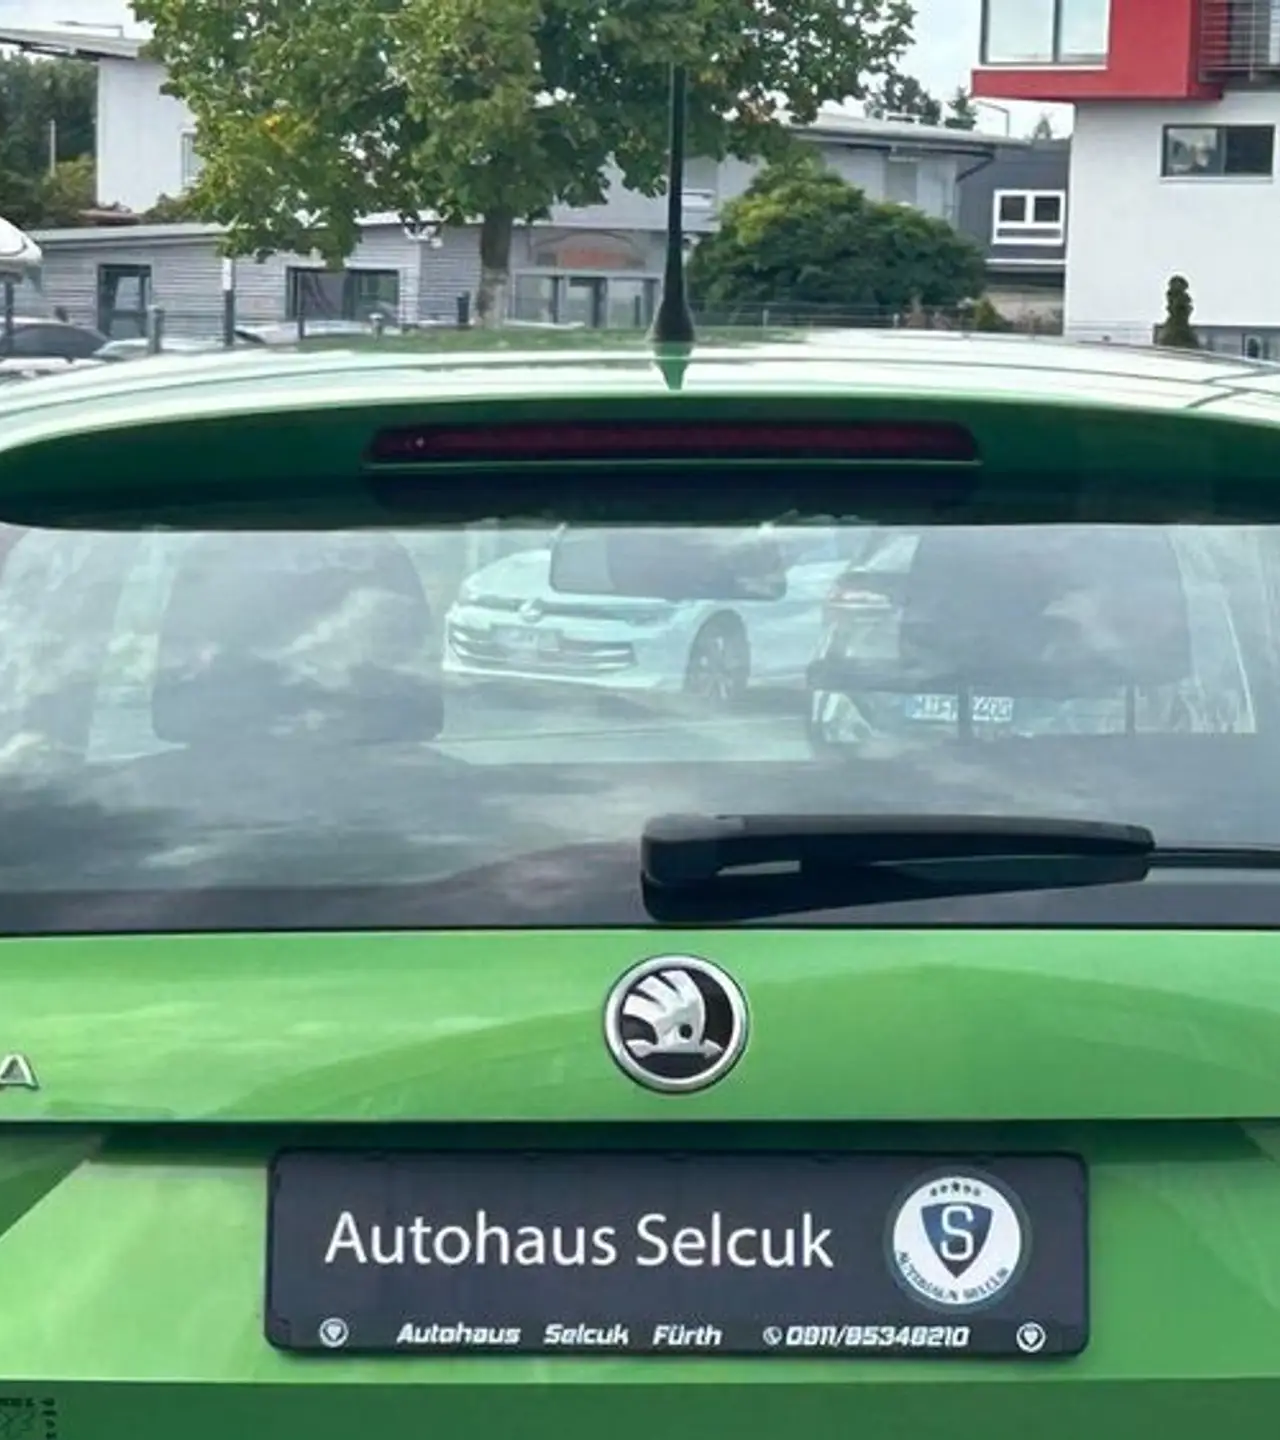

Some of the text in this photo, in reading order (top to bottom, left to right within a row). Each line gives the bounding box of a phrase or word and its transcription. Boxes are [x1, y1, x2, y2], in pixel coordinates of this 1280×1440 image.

[324, 1209, 834, 1269] Autohaus Selcuk
[939, 1204, 975, 1262] S
[396, 1320, 522, 1346] Autohaus
[542, 1323, 630, 1346] Selcuk
[652, 1324, 722, 1347] Fürth
